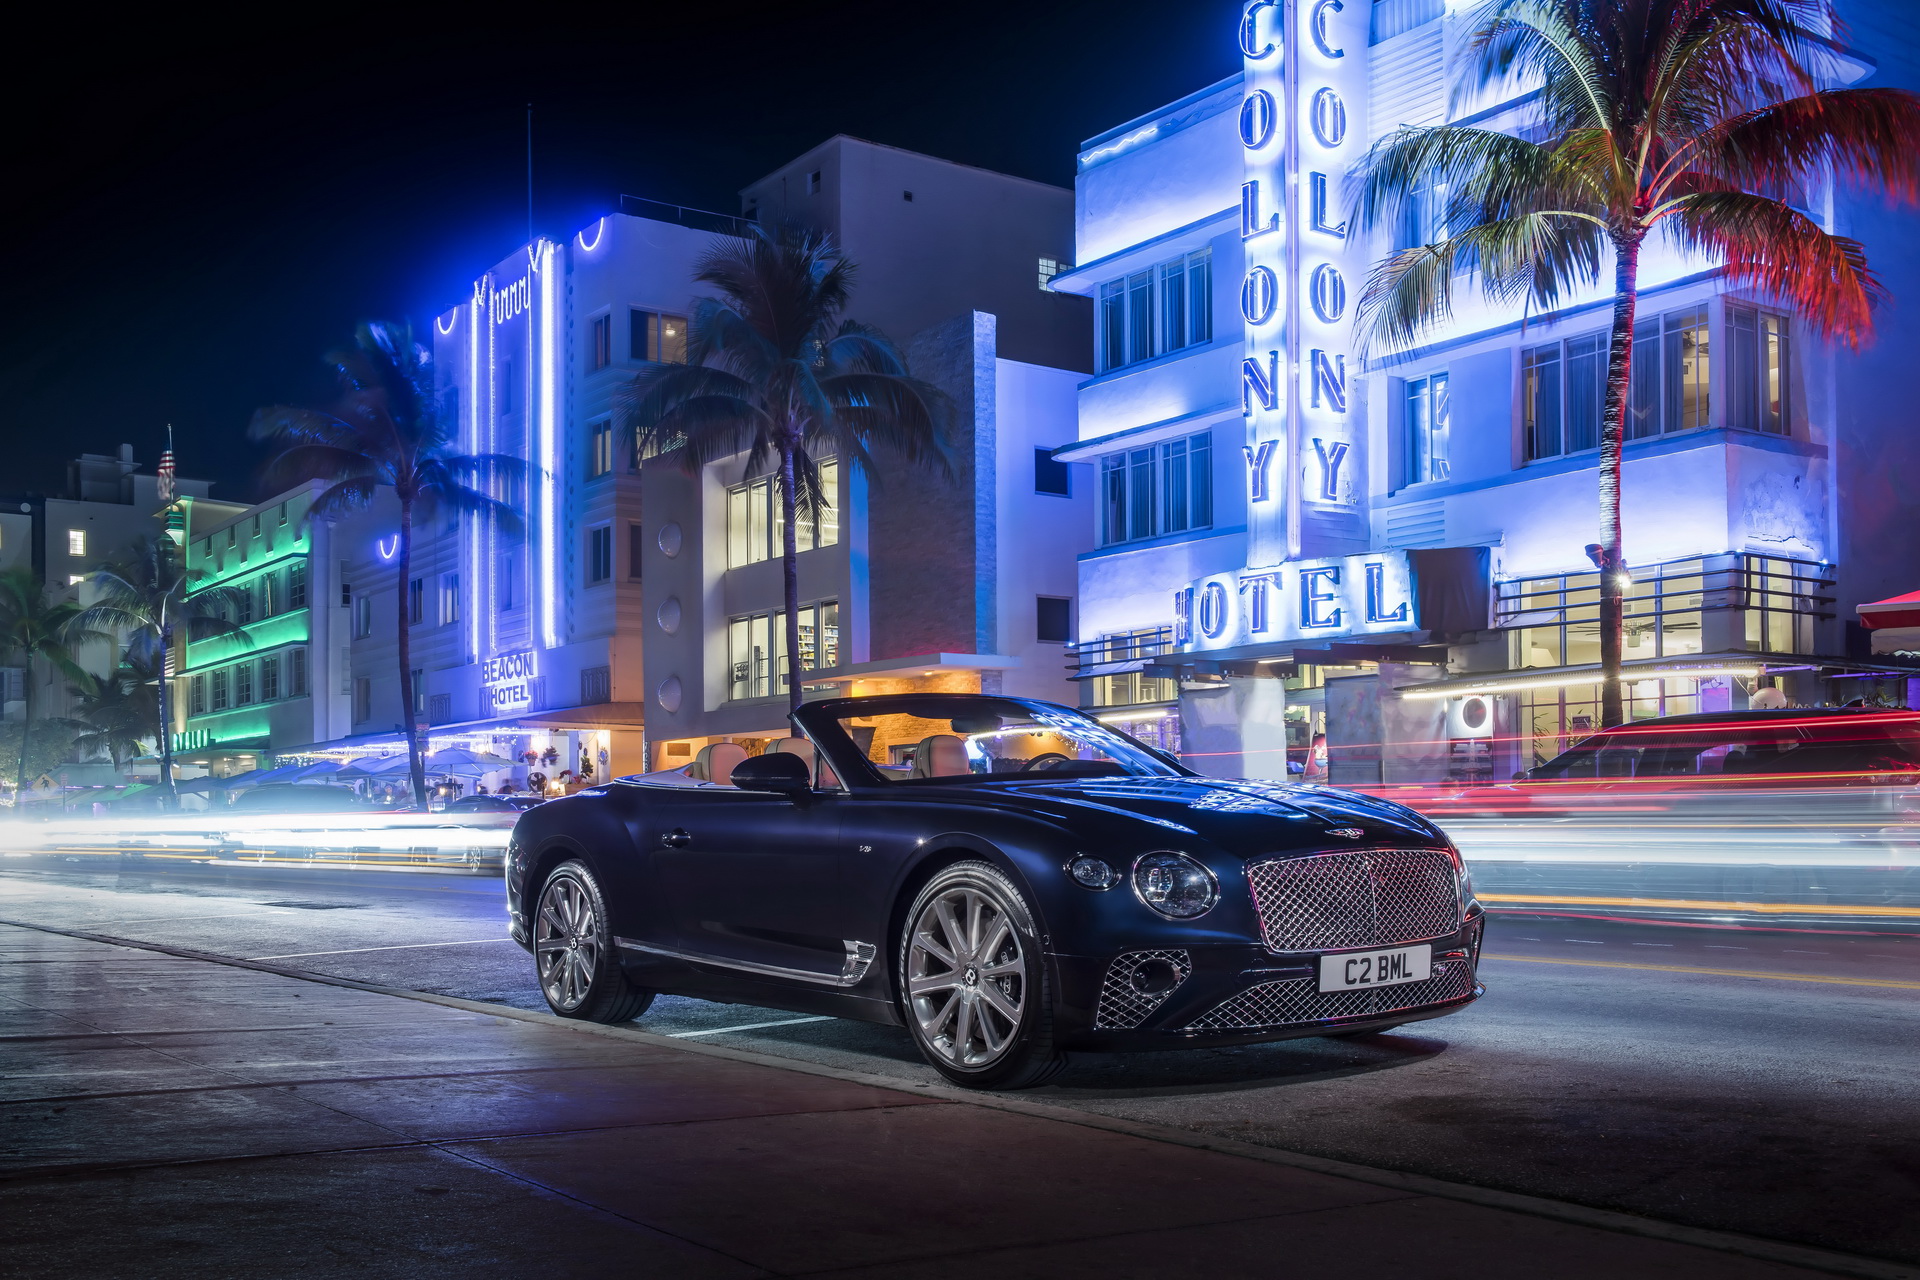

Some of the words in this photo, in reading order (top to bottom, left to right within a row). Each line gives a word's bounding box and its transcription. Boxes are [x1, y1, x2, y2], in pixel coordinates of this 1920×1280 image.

[1238, 0, 1279, 503] COLONY
[1309, 0, 1350, 501] COLONY
[1172, 562, 1407, 647] HOTEL
[482, 653, 534, 683] BEACON
[491, 685, 529, 705] HOTEL
[1345, 957, 1371, 985] C2
[1377, 953, 1413, 982] BML
